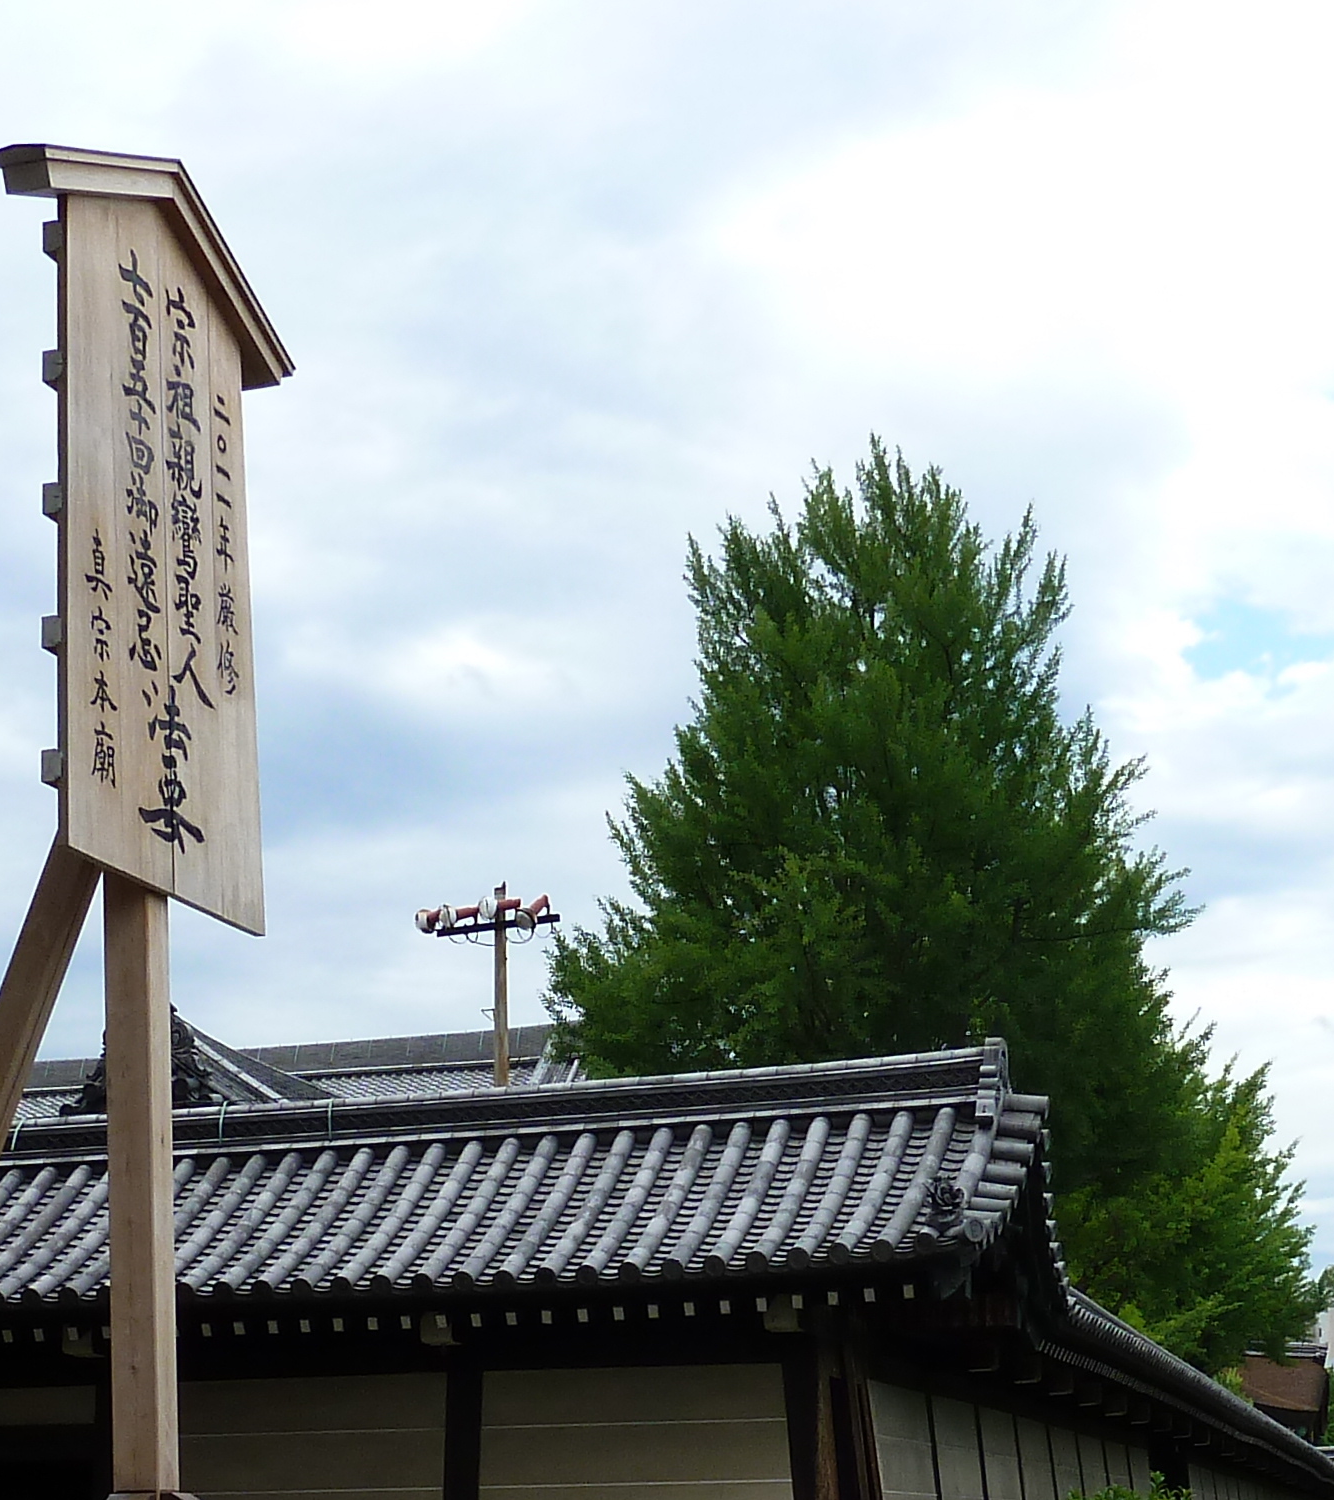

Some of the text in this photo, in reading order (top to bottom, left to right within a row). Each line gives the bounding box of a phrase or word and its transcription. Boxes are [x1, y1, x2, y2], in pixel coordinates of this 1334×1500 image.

[166, 287, 215, 709] 宗祖親鸞聖人
[138, 680, 205, 853] 法要
